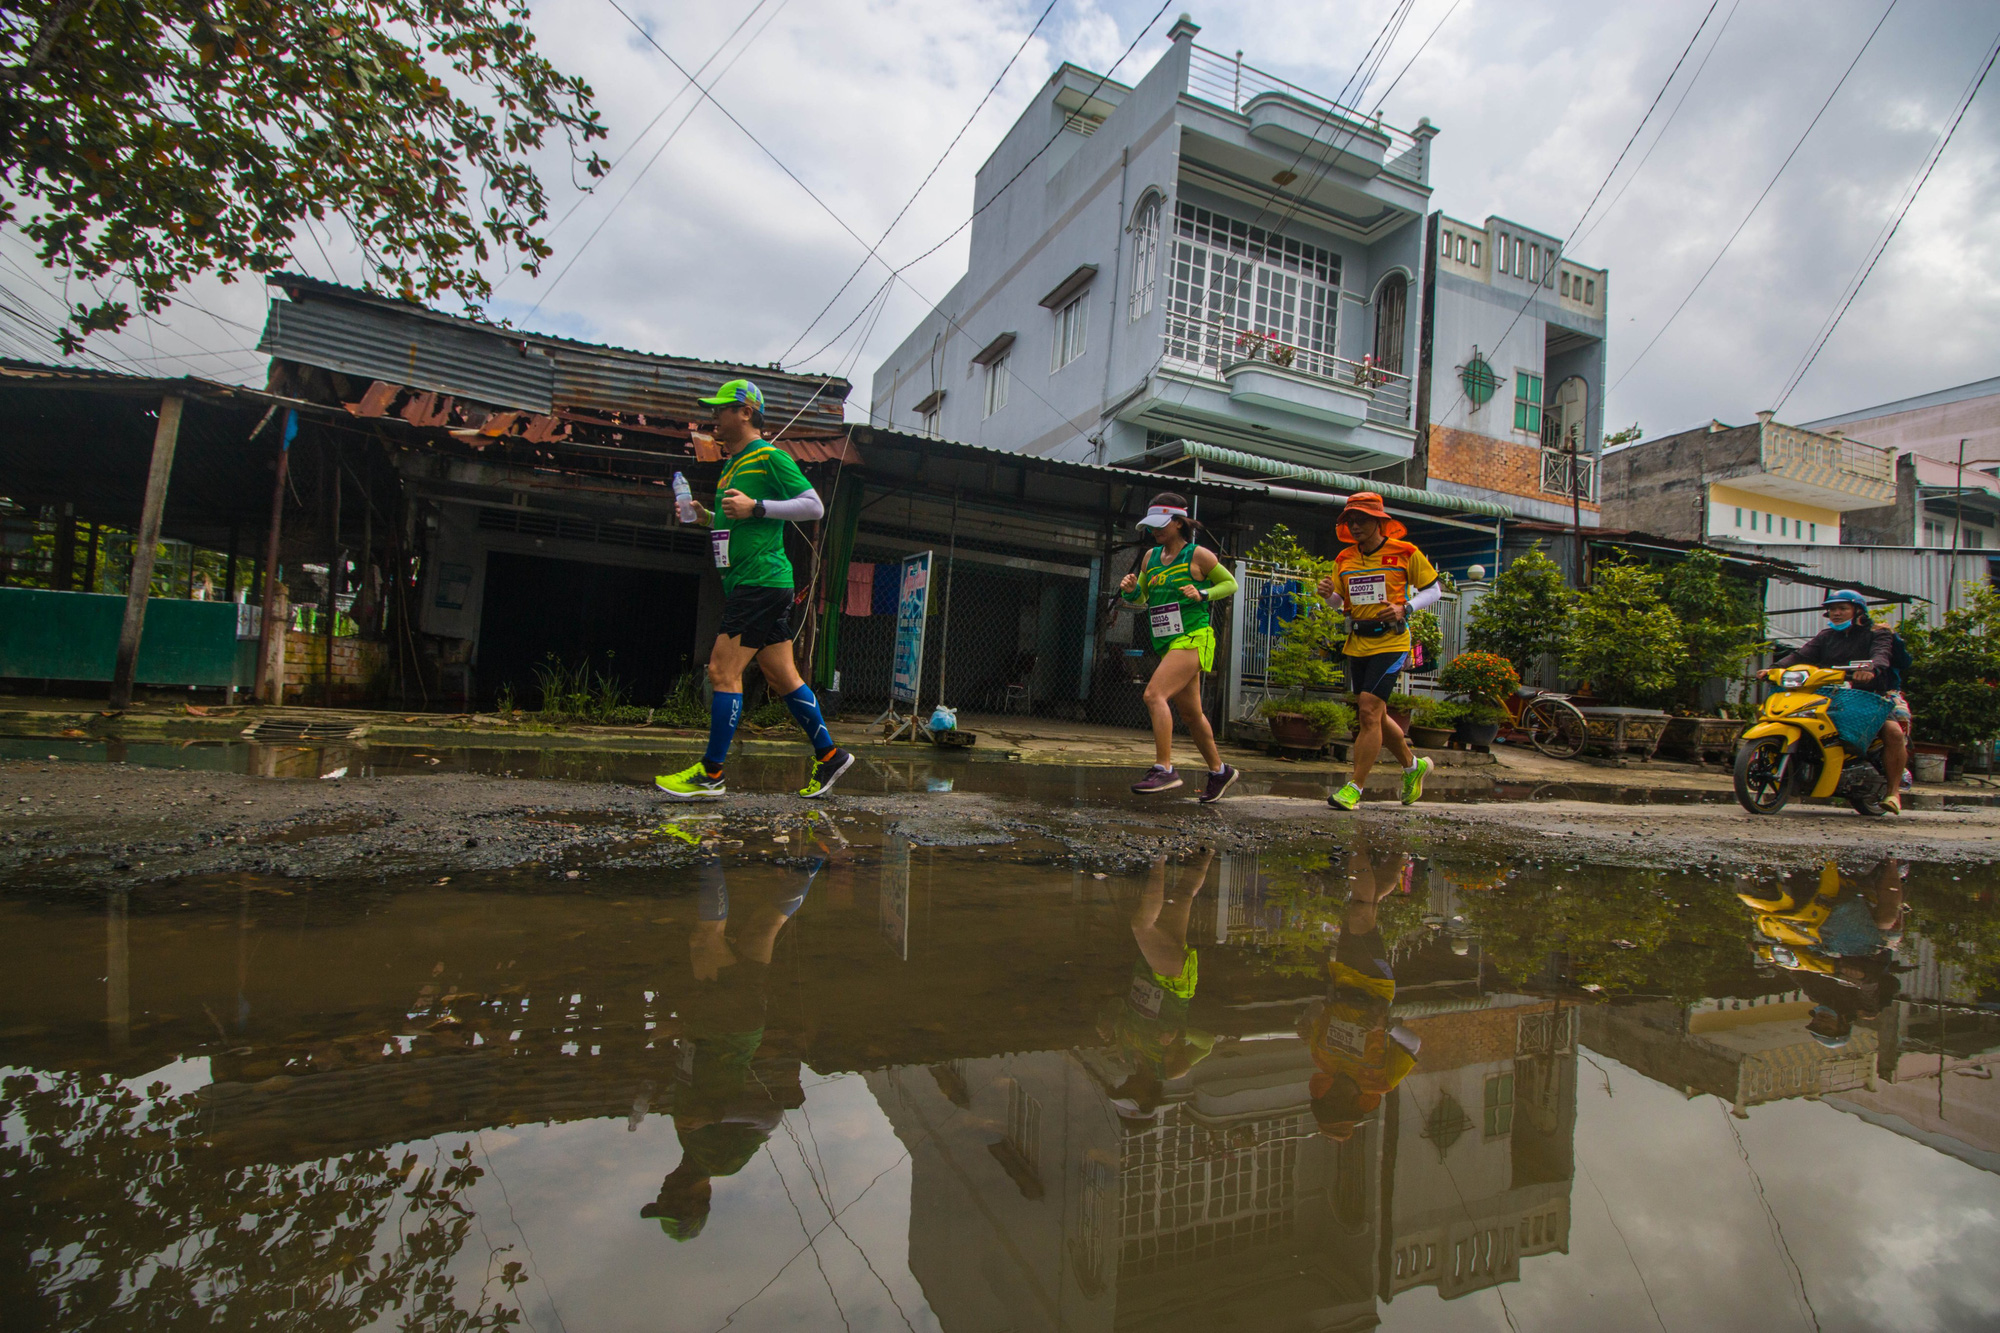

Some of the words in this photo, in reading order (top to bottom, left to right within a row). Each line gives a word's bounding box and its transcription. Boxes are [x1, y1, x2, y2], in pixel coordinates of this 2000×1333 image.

[1350, 584, 1374, 593] 420073
[1174, 623, 1181, 633] 42
[729, 699, 740, 728] 2XU
